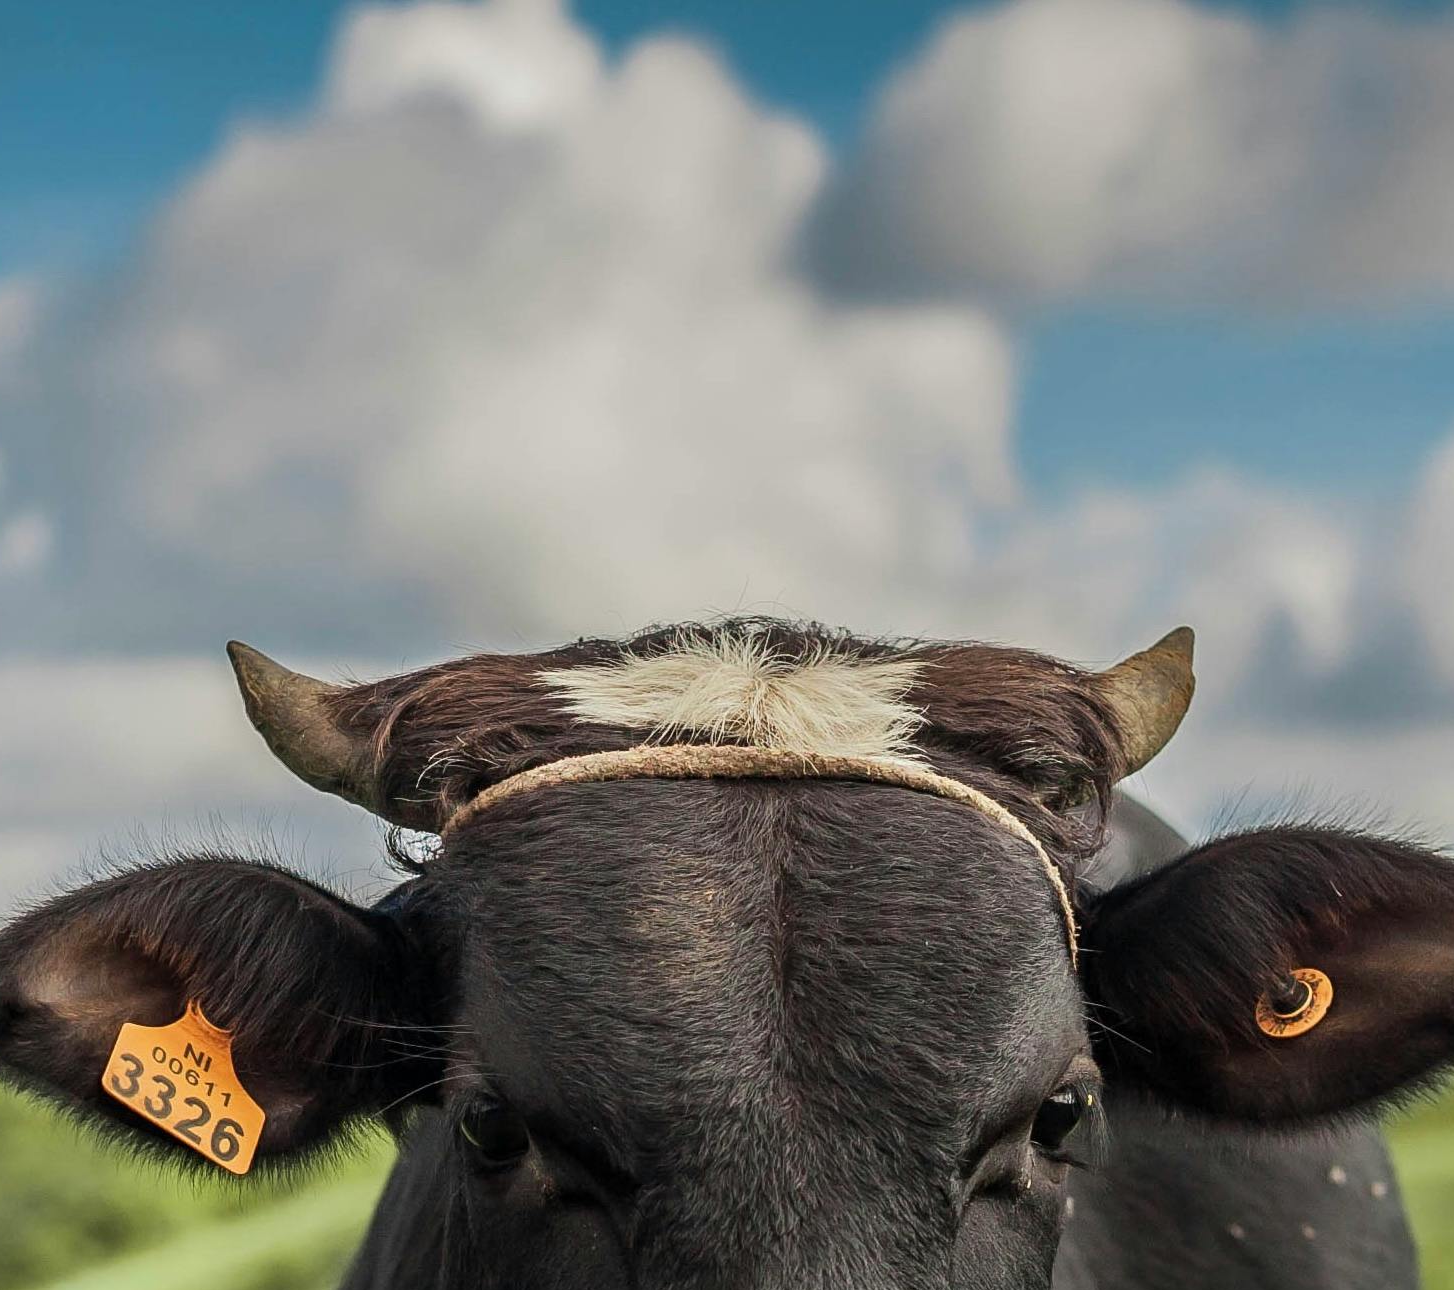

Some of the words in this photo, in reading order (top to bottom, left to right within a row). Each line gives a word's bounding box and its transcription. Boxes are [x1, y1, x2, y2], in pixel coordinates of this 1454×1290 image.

[151, 1046, 232, 1108] 00611
[183, 1042, 213, 1072] NI
[111, 1053, 245, 1162] 3326
